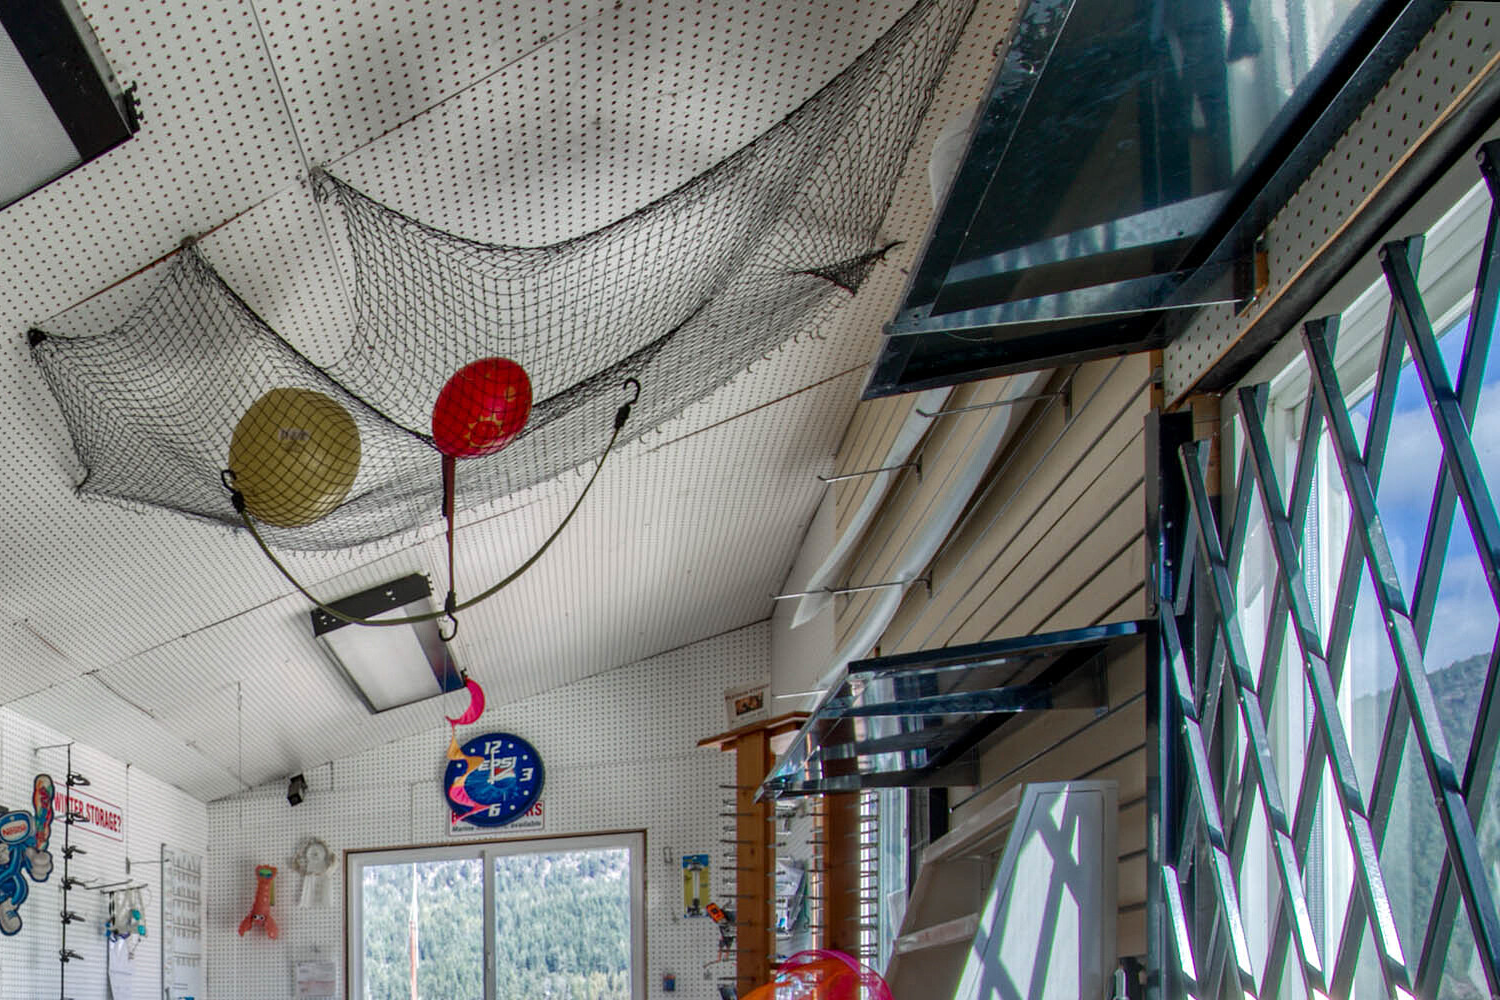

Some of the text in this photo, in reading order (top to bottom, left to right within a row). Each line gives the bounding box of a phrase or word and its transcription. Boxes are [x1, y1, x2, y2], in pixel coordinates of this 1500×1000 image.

[484, 741, 503, 755] 12
[477, 756, 518, 772] EPSI
[519, 767, 534, 782] 3
[487, 803, 502, 817] 6
[85, 802, 122, 834] STORAGE?
